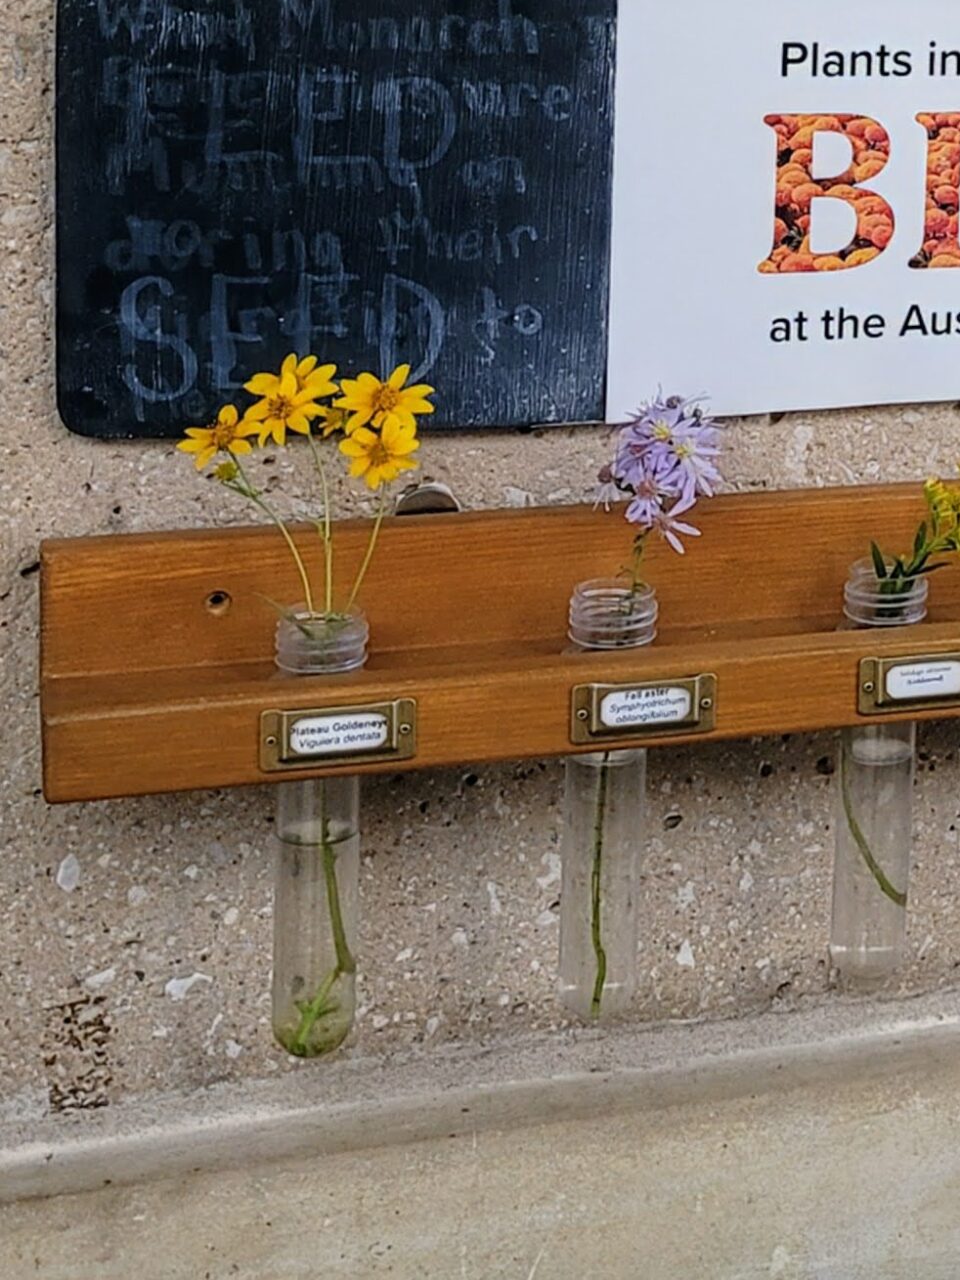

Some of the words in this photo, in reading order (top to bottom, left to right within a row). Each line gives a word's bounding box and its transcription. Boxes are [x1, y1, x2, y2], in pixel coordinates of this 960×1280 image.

[780, 42, 911, 78] Plants
[770, 310, 808, 343] at
[821, 304, 886, 339] the
[343, 731, 381, 744] dentata
